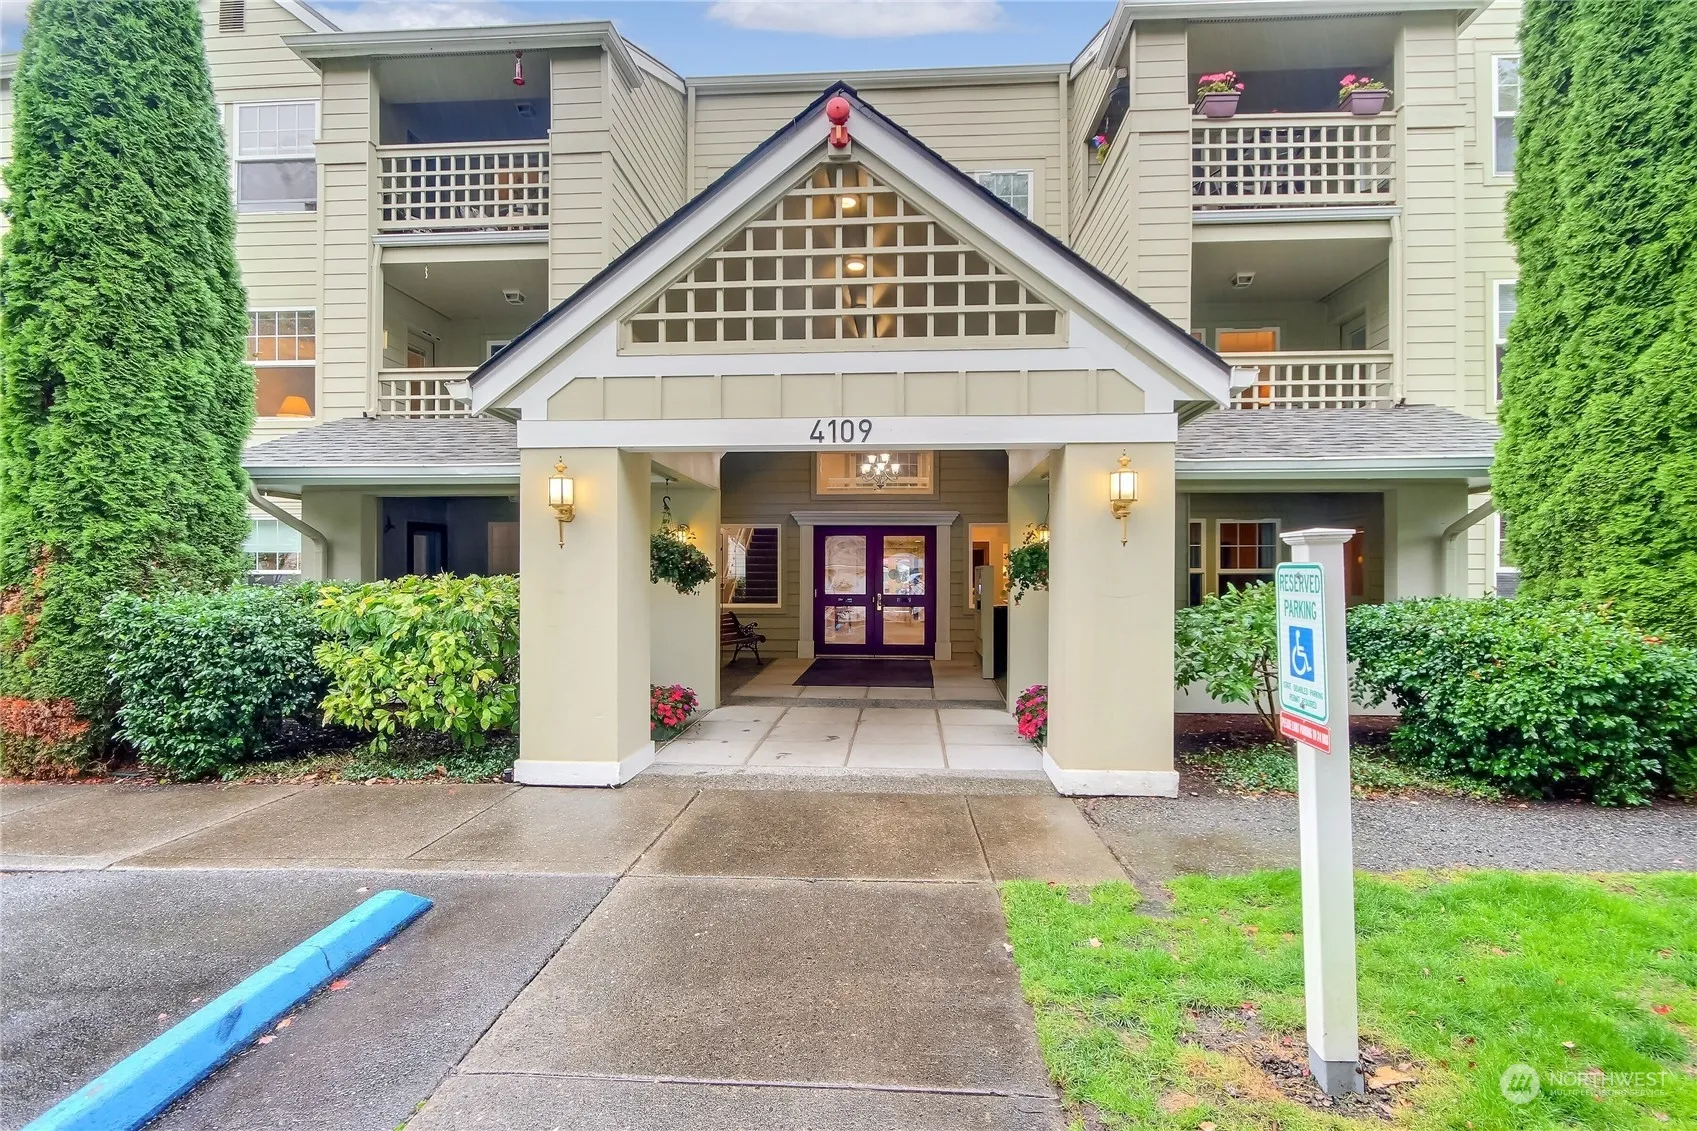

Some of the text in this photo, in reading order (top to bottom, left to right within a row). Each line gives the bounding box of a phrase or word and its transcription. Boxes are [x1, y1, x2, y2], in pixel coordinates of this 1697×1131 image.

[809, 418, 873, 443] 4109
[1279, 573, 1320, 593] RESERVED
[1284, 599, 1317, 620] PARKING
